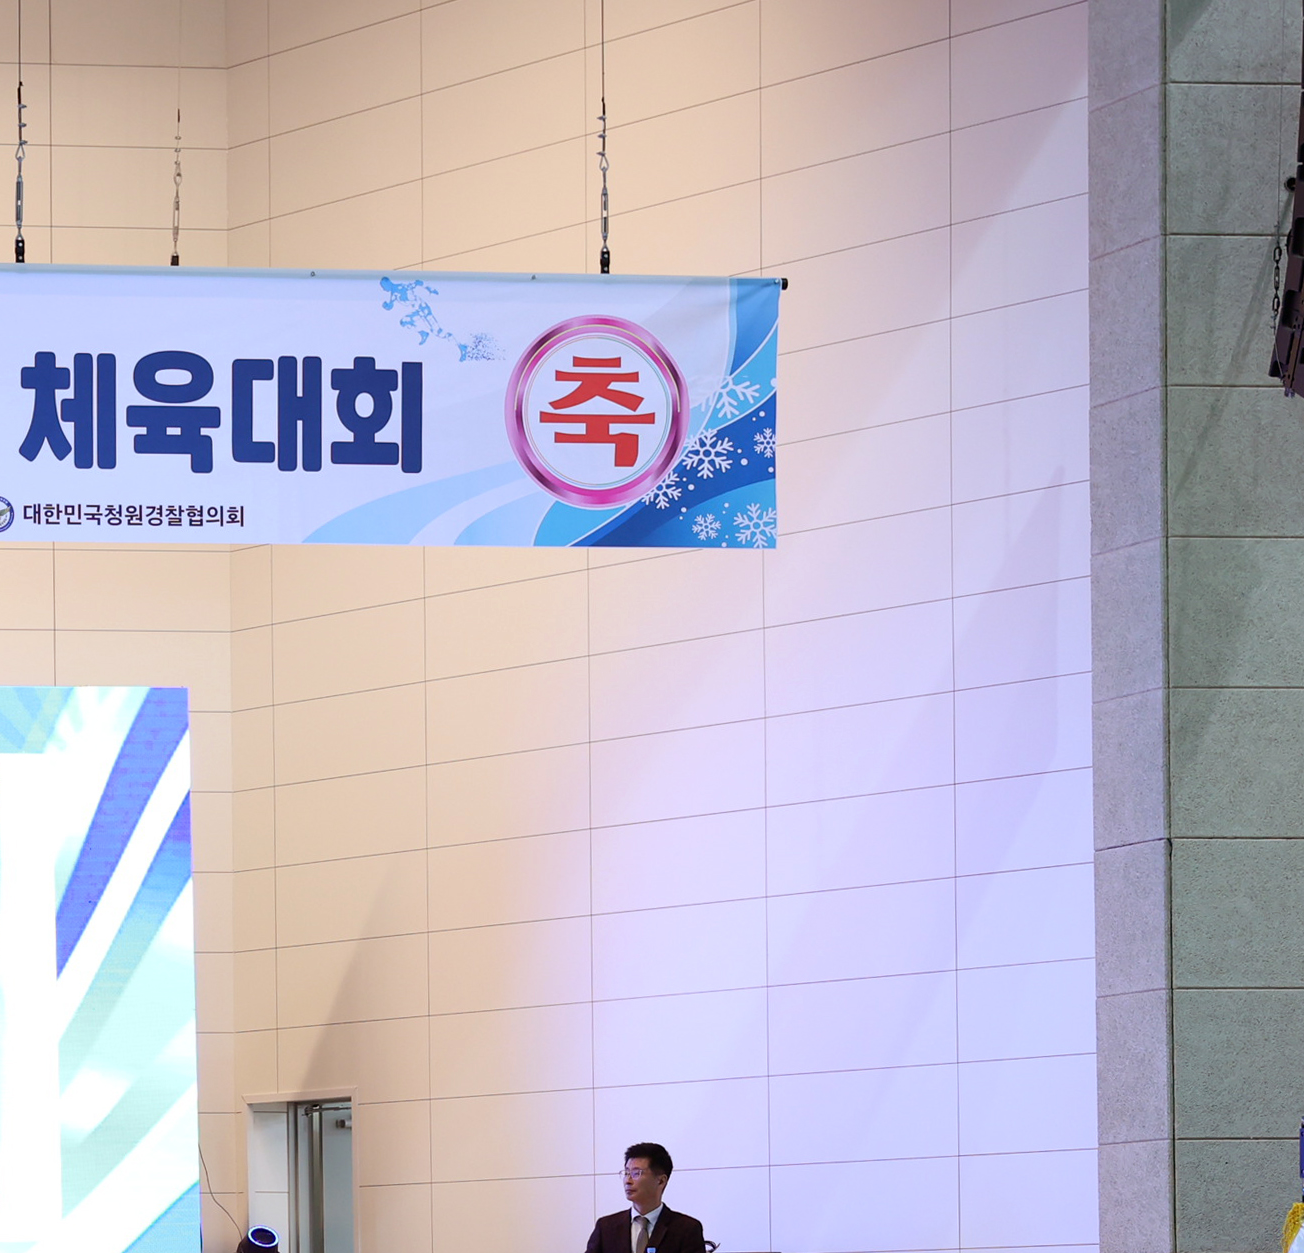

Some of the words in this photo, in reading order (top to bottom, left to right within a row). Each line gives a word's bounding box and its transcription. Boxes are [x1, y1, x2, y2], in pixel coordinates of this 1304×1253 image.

[18, 350, 424, 474] 체육대회
[539, 355, 655, 467] 축
[23, 503, 245, 528] 대한민국청원경찰협의회
